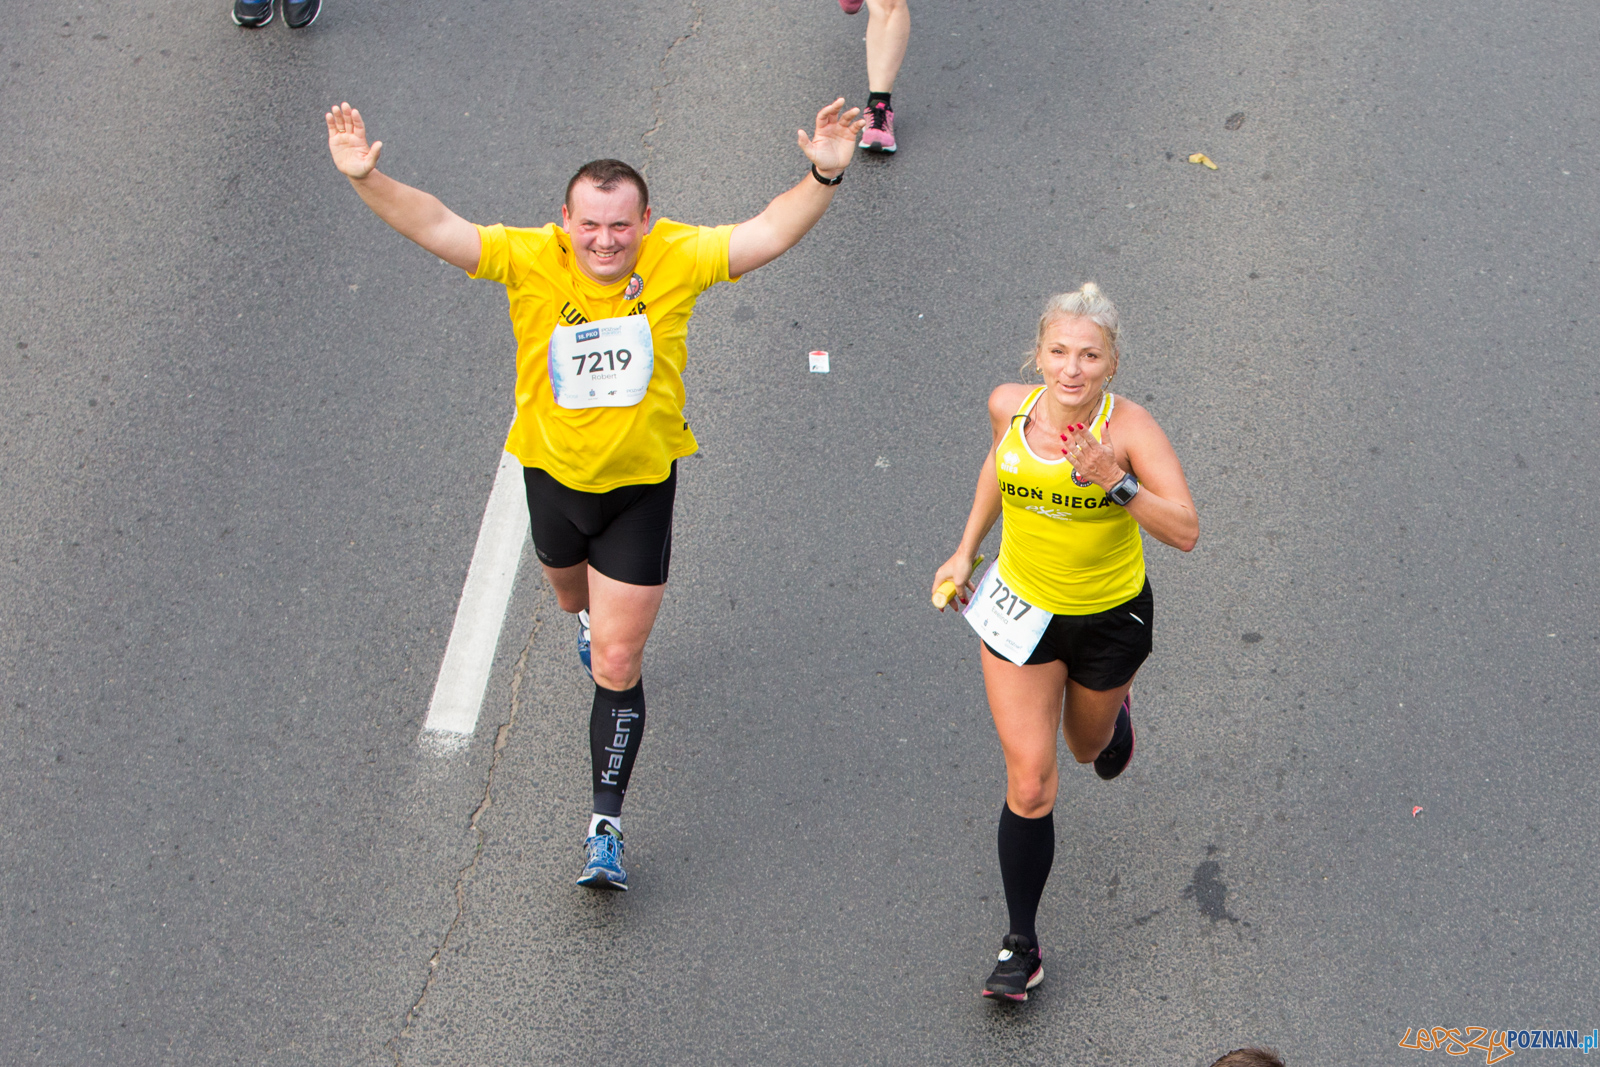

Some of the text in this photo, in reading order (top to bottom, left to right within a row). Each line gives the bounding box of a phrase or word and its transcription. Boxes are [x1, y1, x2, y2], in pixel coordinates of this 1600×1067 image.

[586, 331, 599, 339] PKO
[572, 349, 632, 376] 7219
[591, 373, 617, 381] Robert
[1051, 493, 1110, 509] BIEGA
[990, 577, 1032, 621] 7217
